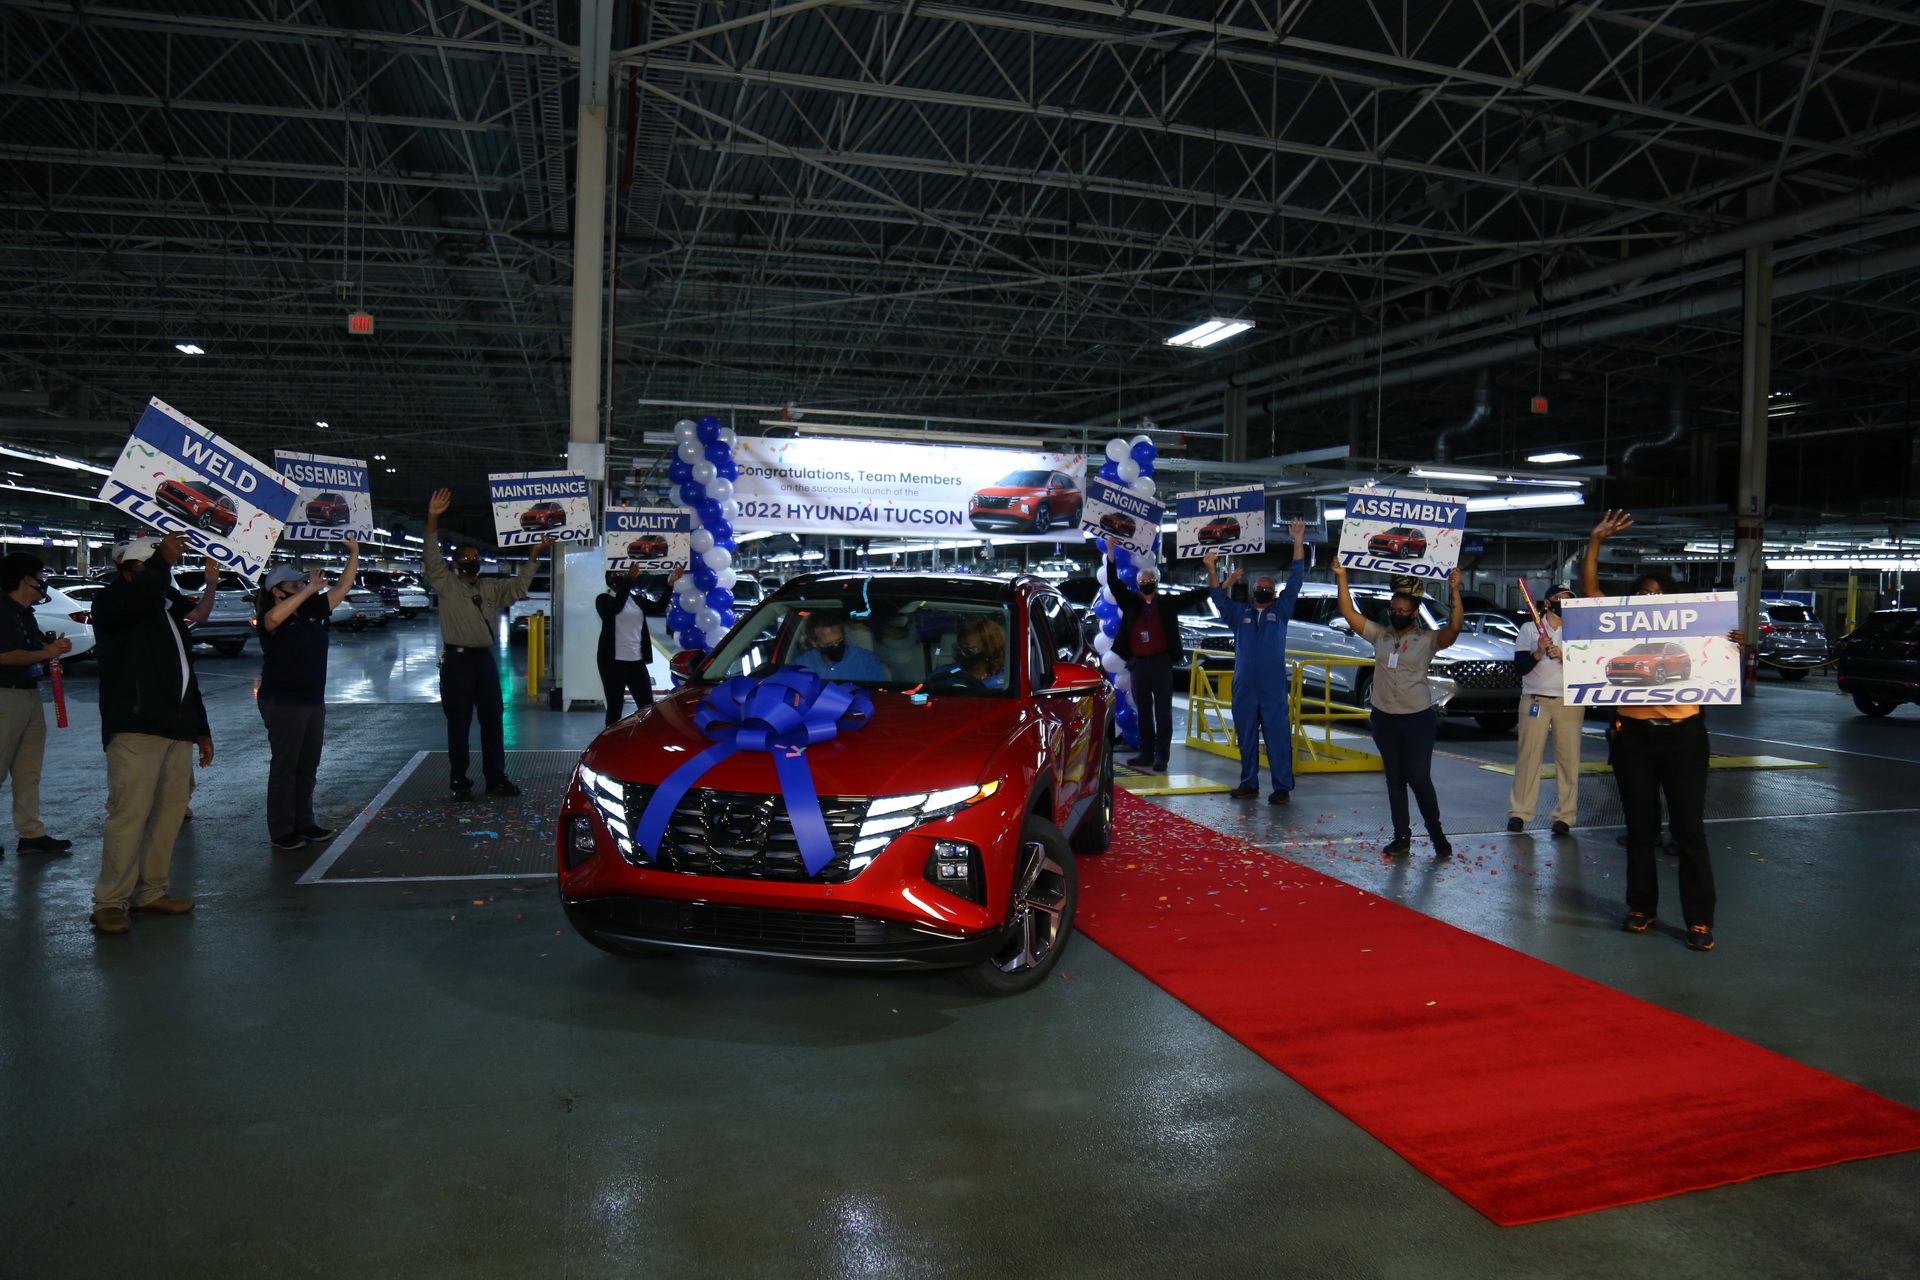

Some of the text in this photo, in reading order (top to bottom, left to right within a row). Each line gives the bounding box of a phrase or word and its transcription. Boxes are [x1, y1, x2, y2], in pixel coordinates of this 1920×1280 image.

[352, 317, 370, 331] EXIT
[181, 434, 257, 493] WELD
[284, 463, 363, 487] ASSEMBLY
[737, 464, 962, 486] Congratulations, Team Members
[491, 481, 586, 498] MAINTENANCE
[795, 484, 810, 492] the
[812, 485, 859, 494] successful
[861, 486, 892, 495] launch
[893, 487, 903, 496] of
[904, 488, 919, 496] the
[736, 501, 963, 525] 2022 HYUNDAI TUCSON
[1102, 489, 1150, 517] ENGINE
[1197, 496, 1241, 513] PAINT
[1351, 498, 1459, 524] ASSEMBLY
[109, 479, 261, 576] TUCSON
[285, 521, 372, 541] TUCSON
[617, 515, 679, 530] QUALITY
[1340, 551, 1453, 579] TUCSON
[1598, 609, 1698, 633] STAMP
[1567, 681, 1737, 703] TUCSON
